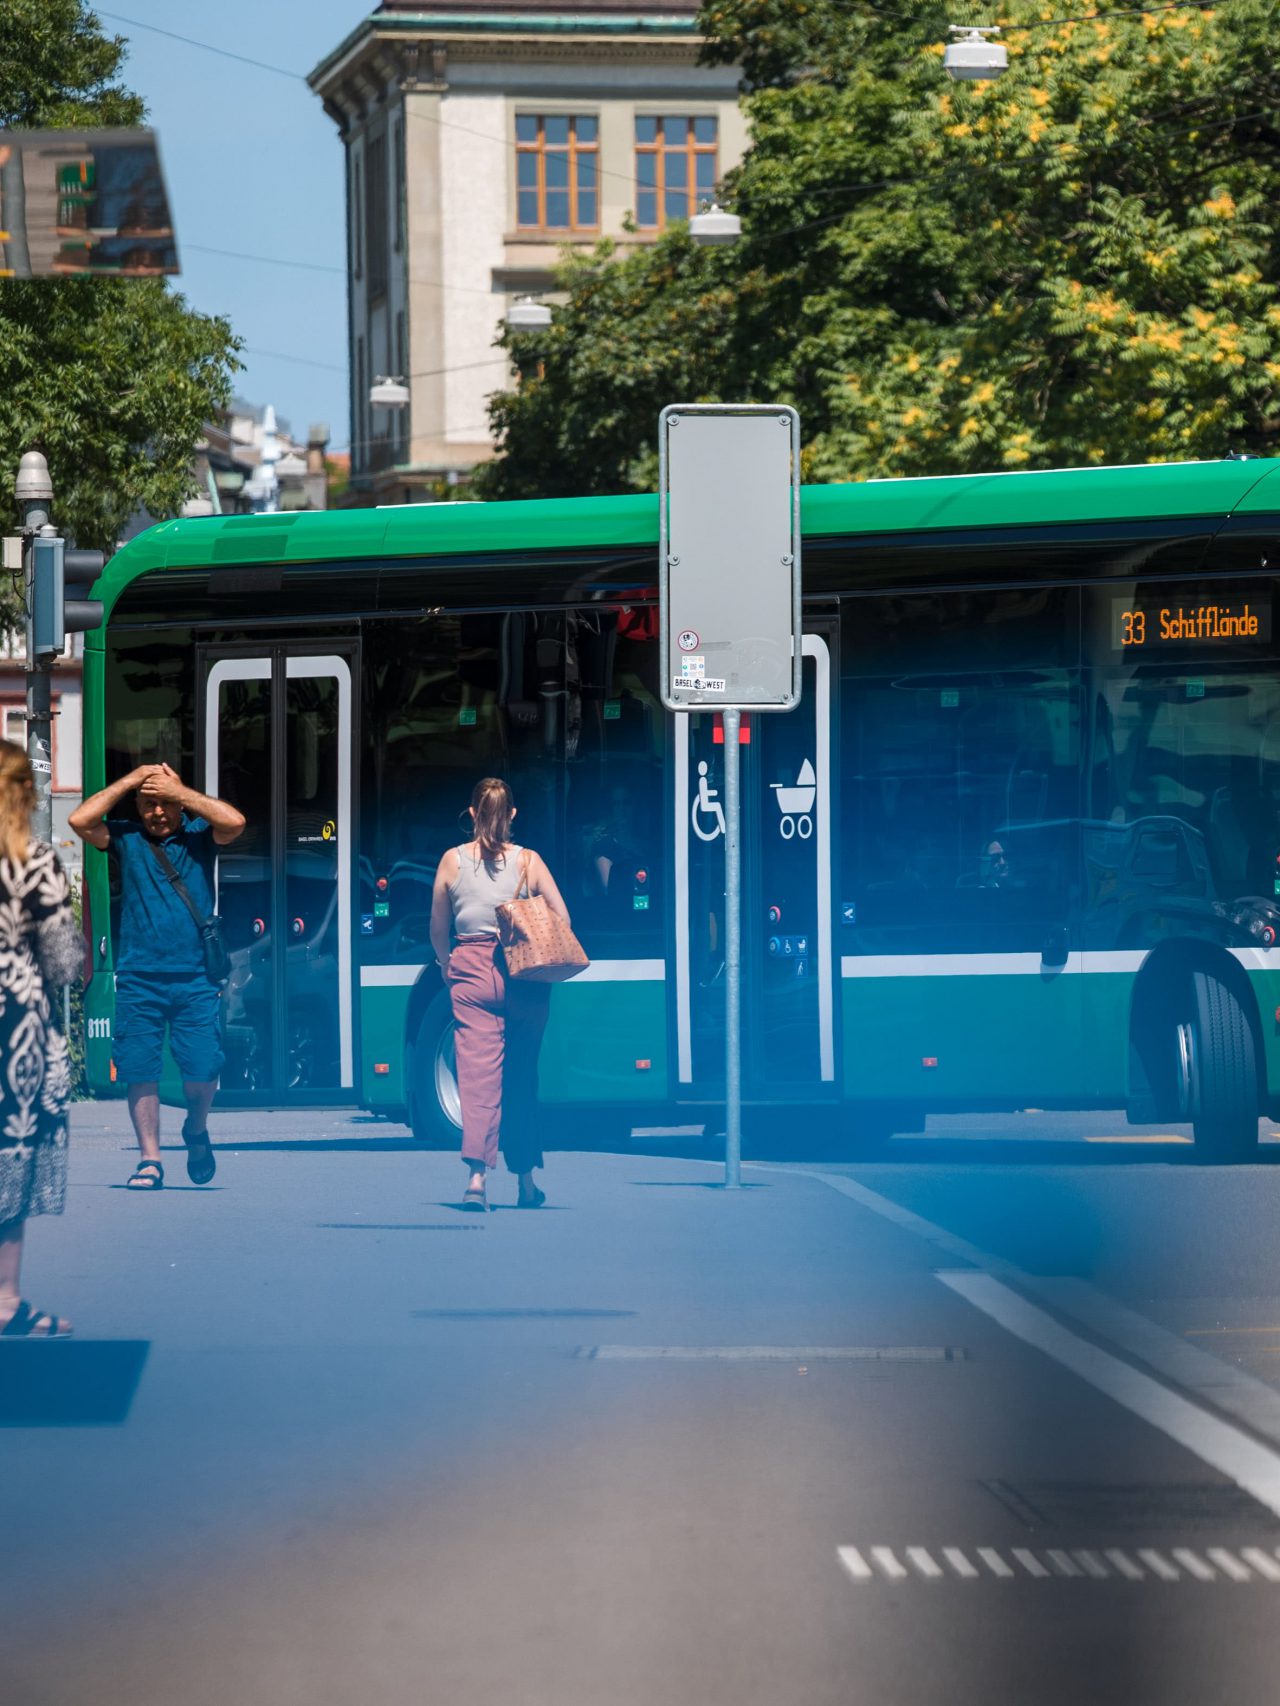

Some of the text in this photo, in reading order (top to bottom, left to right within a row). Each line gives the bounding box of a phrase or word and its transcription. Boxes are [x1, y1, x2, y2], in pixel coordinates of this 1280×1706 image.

[1121, 605, 1259, 644] 33 Schifflände
[675, 679, 724, 689] BASEL WEST
[87, 1017, 111, 1039] 8111
